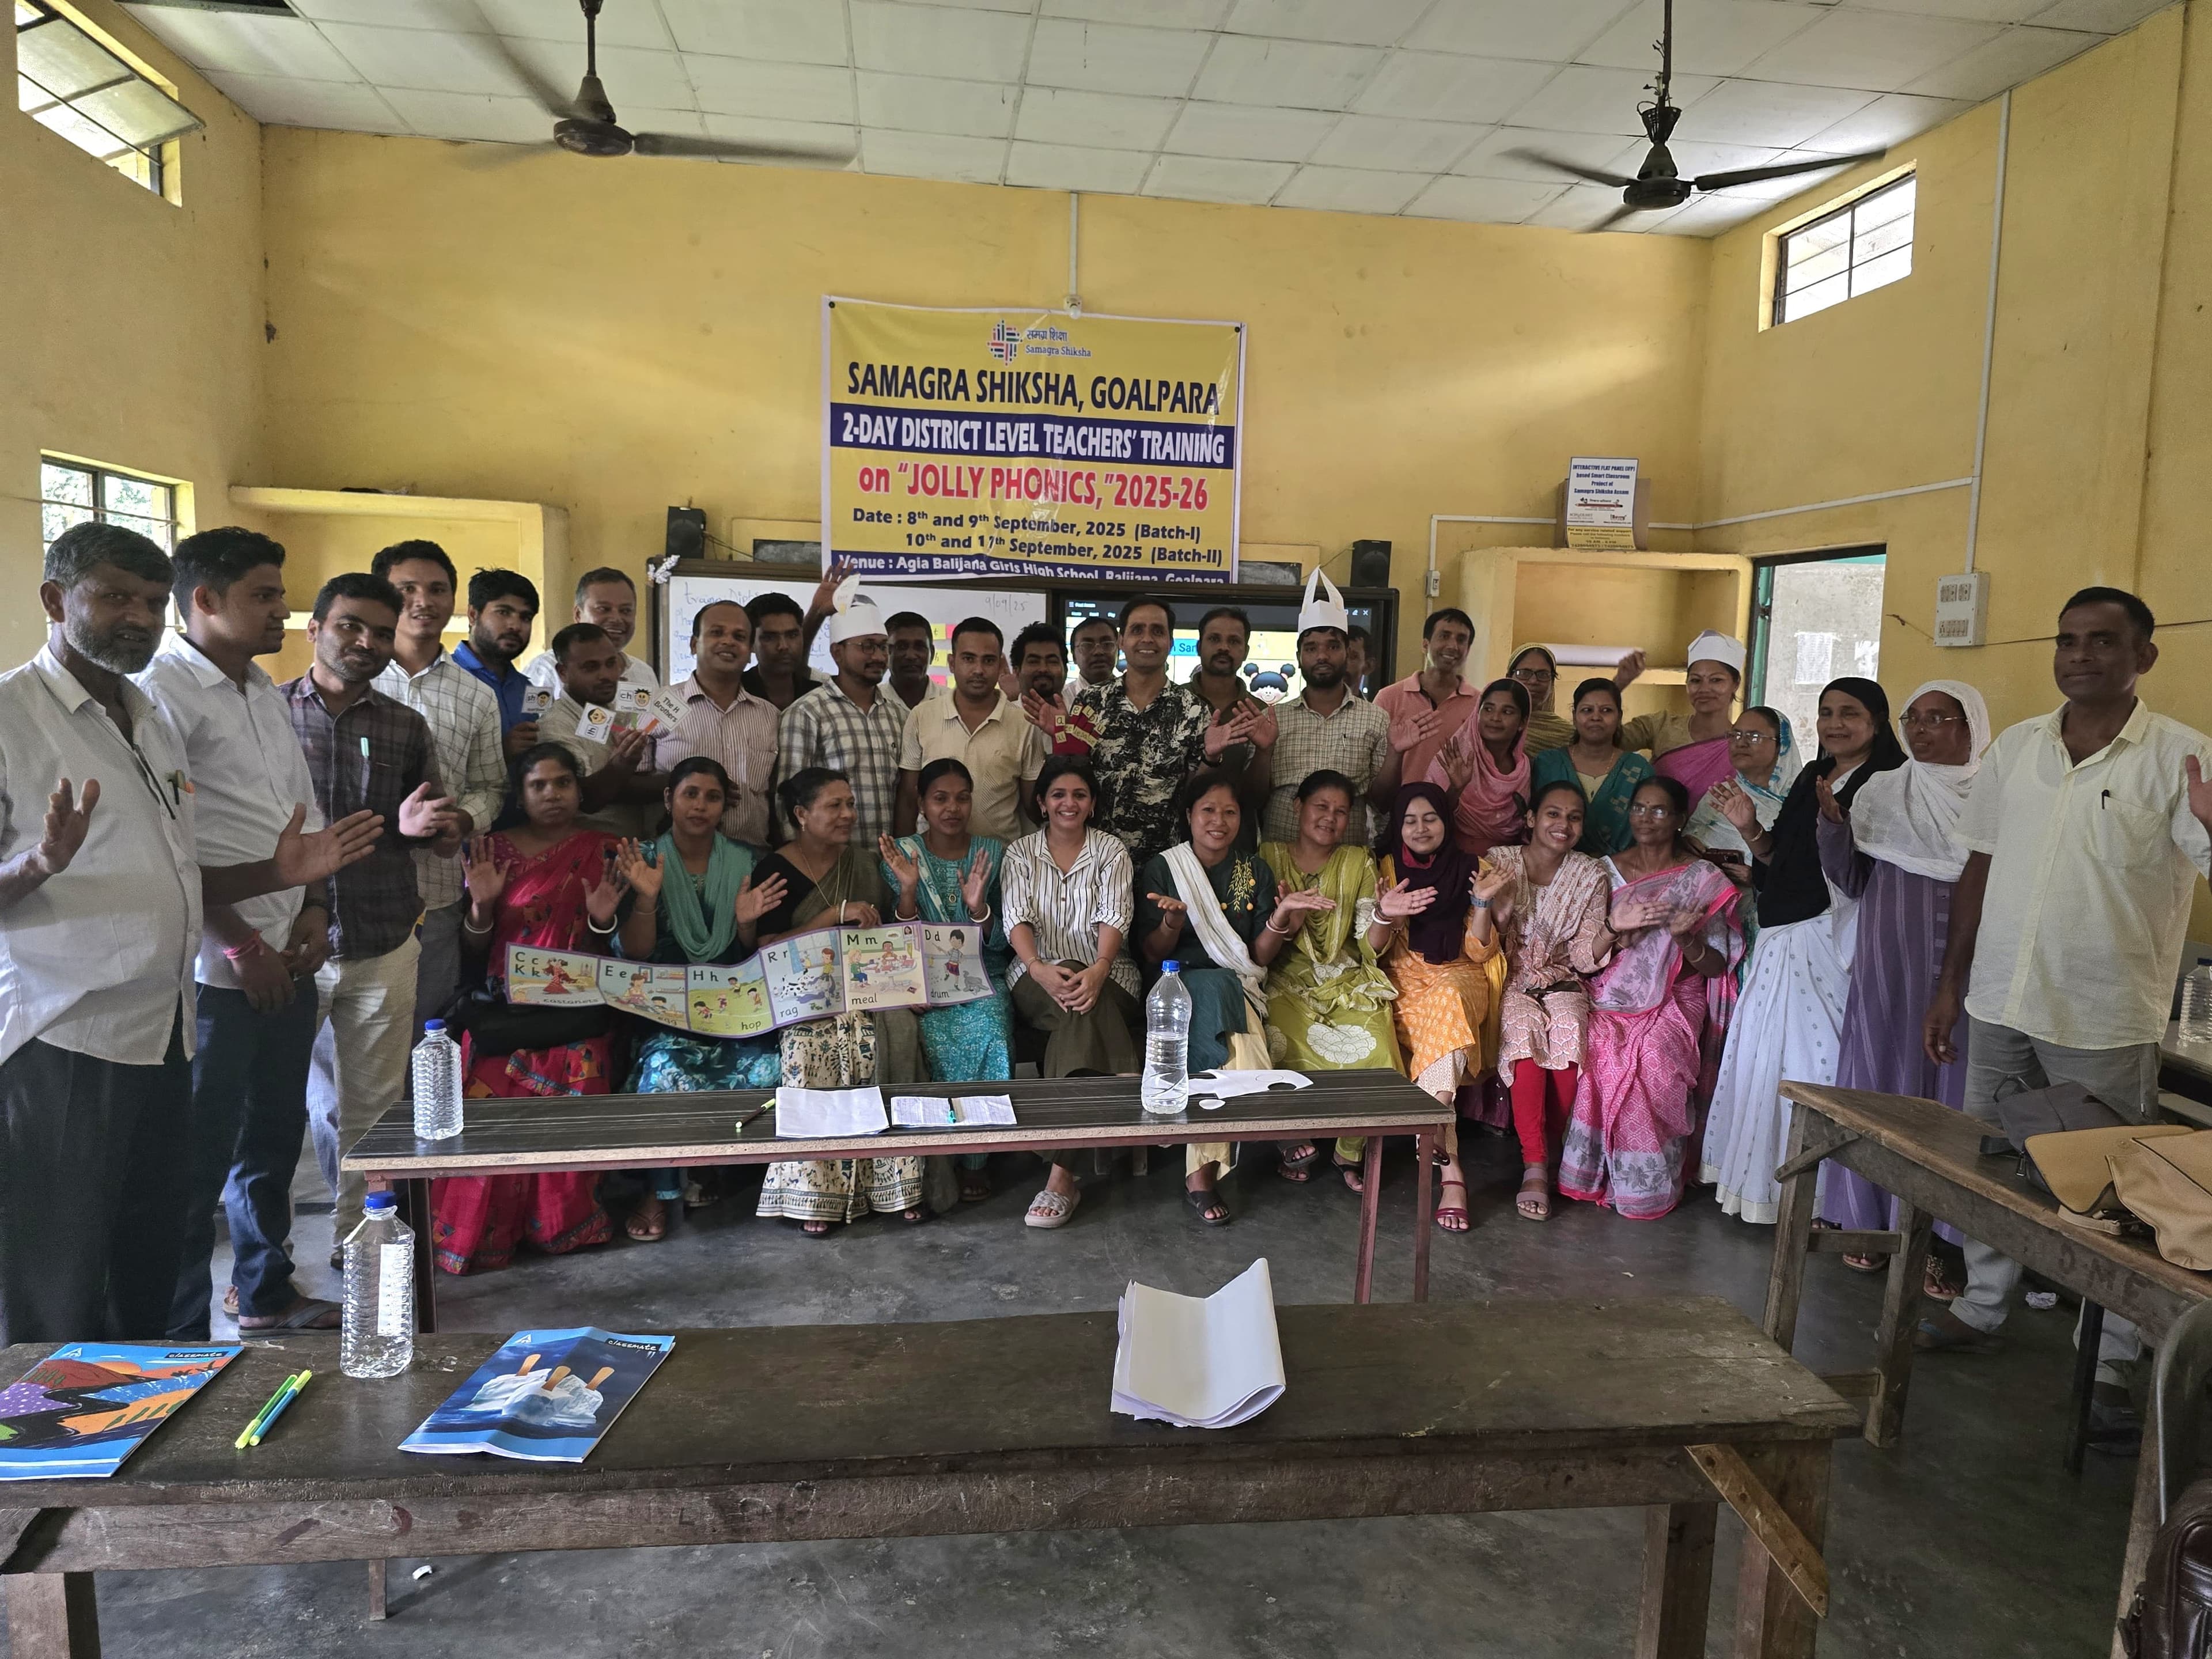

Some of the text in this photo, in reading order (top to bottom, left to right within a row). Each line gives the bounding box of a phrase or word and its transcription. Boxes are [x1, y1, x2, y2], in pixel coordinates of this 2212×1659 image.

[1027, 327, 1067, 341] समग्र शिक्षा
[1026, 345, 1091, 357] Samagra Shiksha
[848, 361, 1219, 415] SAMAGRA SHIKSHA, GOALPARA
[843, 412, 1225, 463] 2-DAY DISTRICT LEVEL TEACHERS' TRAINING
[859, 467, 890, 493] on
[854, 508, 892, 524] Date
[907, 511, 928, 525] 8th
[933, 514, 964, 528] and
[969, 514, 989, 528] 9th
[994, 515, 1081, 537] September,
[1086, 521, 1126, 537] 2025
[1135, 524, 1200, 544] (Batch-I)
[907, 533, 936, 547] 10th
[941, 535, 972, 548] and
[1009, 539, 1098, 560] September,
[1103, 544, 1142, 560] 2025
[1152, 547, 1222, 567] (Batch-II)
[839, 555, 885, 570] Venue
[896, 557, 929, 573] Agia
[990, 559, 1020, 574] Girls
[663, 697, 674, 709] The
[654, 700, 678, 723] Brothers
[1073, 706, 1080, 714] e
[1056, 717, 1065, 725] a
[847, 934, 878, 945] M m
[925, 929, 941, 942] D d
[515, 952, 525, 962] C
[767, 950, 788, 963] R r
[515, 964, 541, 978] K k
[605, 965, 613, 976] E
[694, 971, 719, 982] H h
[851, 993, 878, 1005] meal
[930, 990, 950, 999] drum
[780, 1006, 798, 1018] rag
[657, 1016, 677, 1027] egg
[741, 1020, 762, 1031] hop
[608, 1340, 657, 1351] classmate
